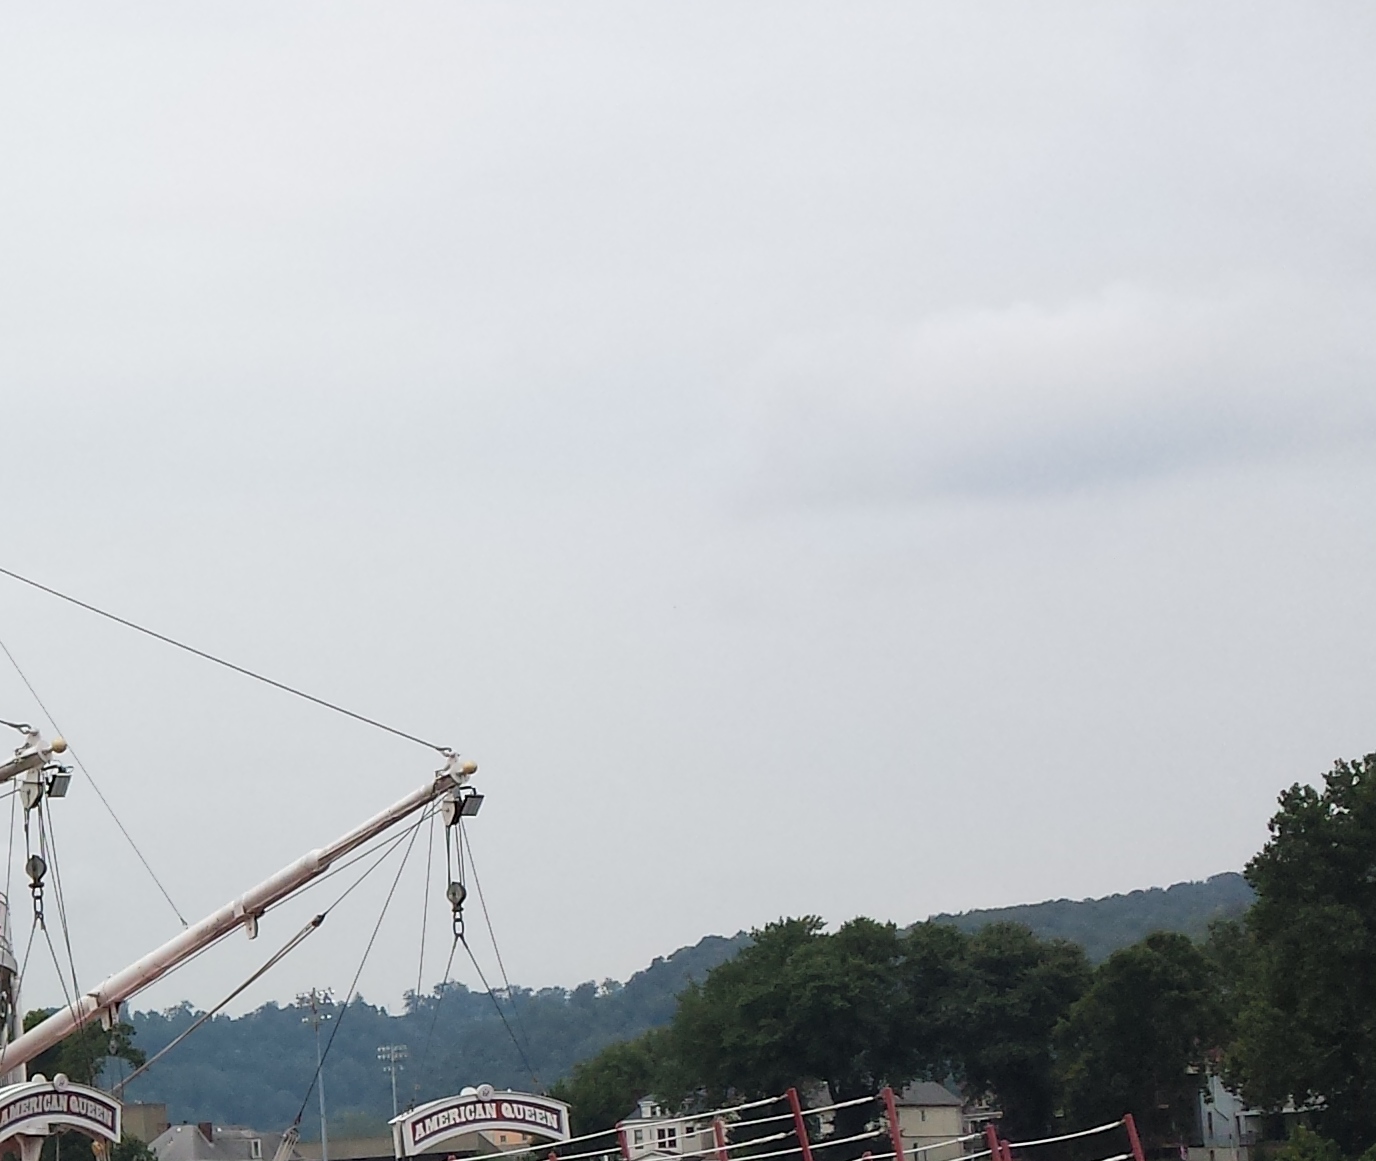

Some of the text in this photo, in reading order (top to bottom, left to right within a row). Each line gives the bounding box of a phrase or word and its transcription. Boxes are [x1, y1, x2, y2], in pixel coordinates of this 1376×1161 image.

[0, 1094, 113, 1127] AMERICAN QUEEN
[414, 1102, 558, 1141] AMERICAN QUEEN
